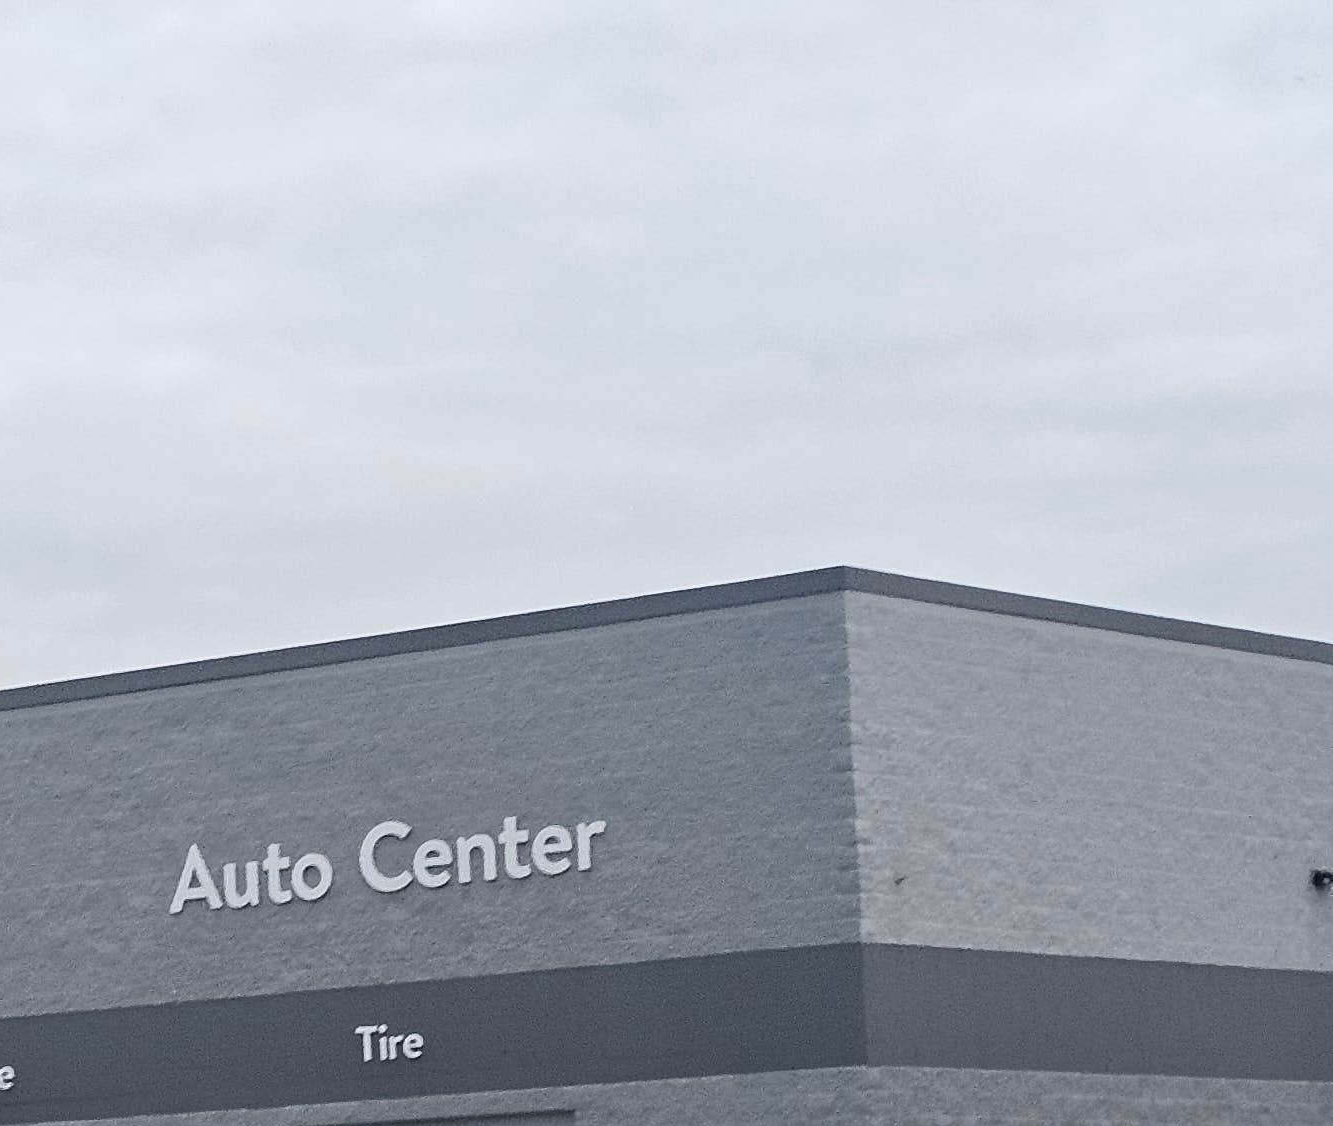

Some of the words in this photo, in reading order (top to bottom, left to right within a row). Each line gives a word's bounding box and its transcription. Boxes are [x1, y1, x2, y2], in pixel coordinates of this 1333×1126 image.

[169, 843, 333, 914] Auto
[359, 816, 607, 893] Center
[354, 1023, 424, 1062] Tire
